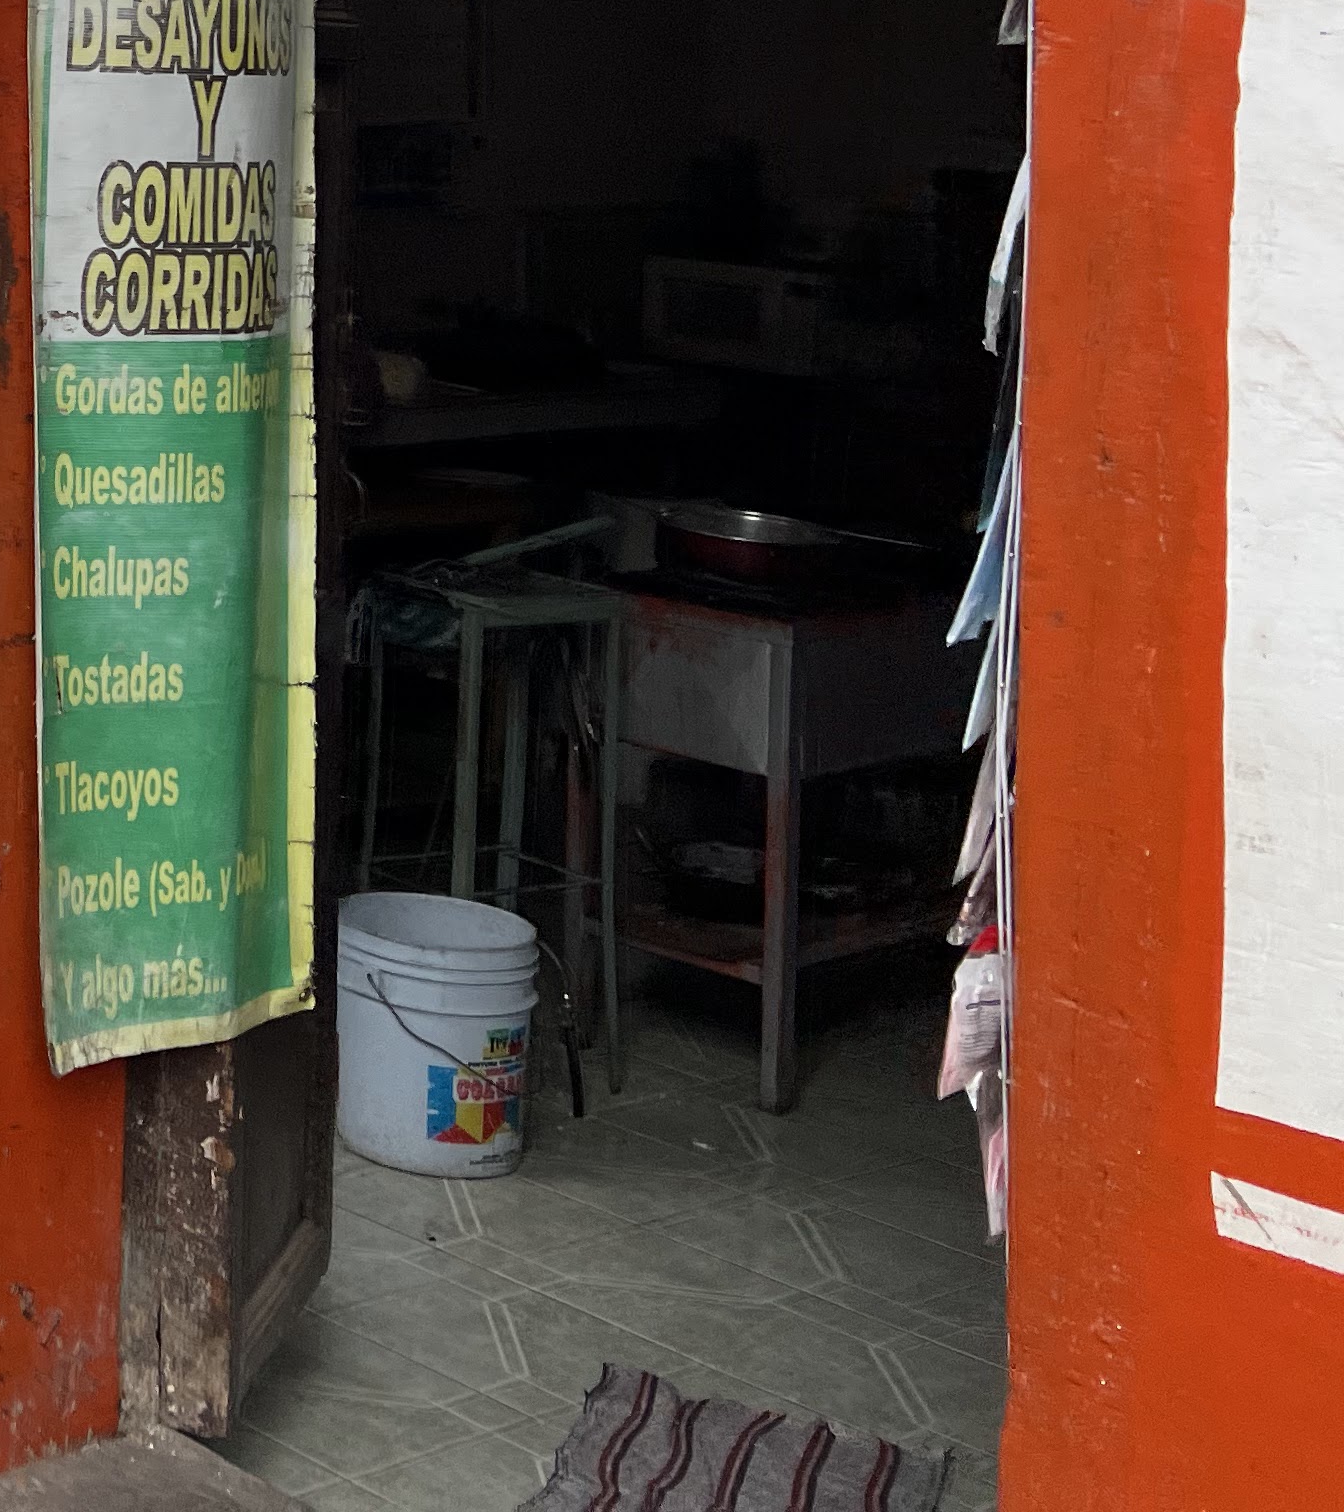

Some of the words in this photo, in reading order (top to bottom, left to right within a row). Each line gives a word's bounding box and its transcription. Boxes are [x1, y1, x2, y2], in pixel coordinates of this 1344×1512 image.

[190, 76, 227, 160] Y
[99, 161, 275, 248] COMIDAS
[82, 248, 278, 335] CORRIDAS
[56, 364, 162, 415] Gordas
[174, 364, 207, 414] de
[55, 452, 225, 508] Quesadillas
[54, 545, 189, 608] Chalupas
[56, 652, 184, 705] Tostadas
[56, 761, 179, 821] Tlacoyos
[57, 861, 140, 918] Pozole
[149, 858, 211, 916] (Sab.
[219, 866, 232, 912] y
[58, 962, 74, 1012] Y
[80, 953, 135, 1021] algo
